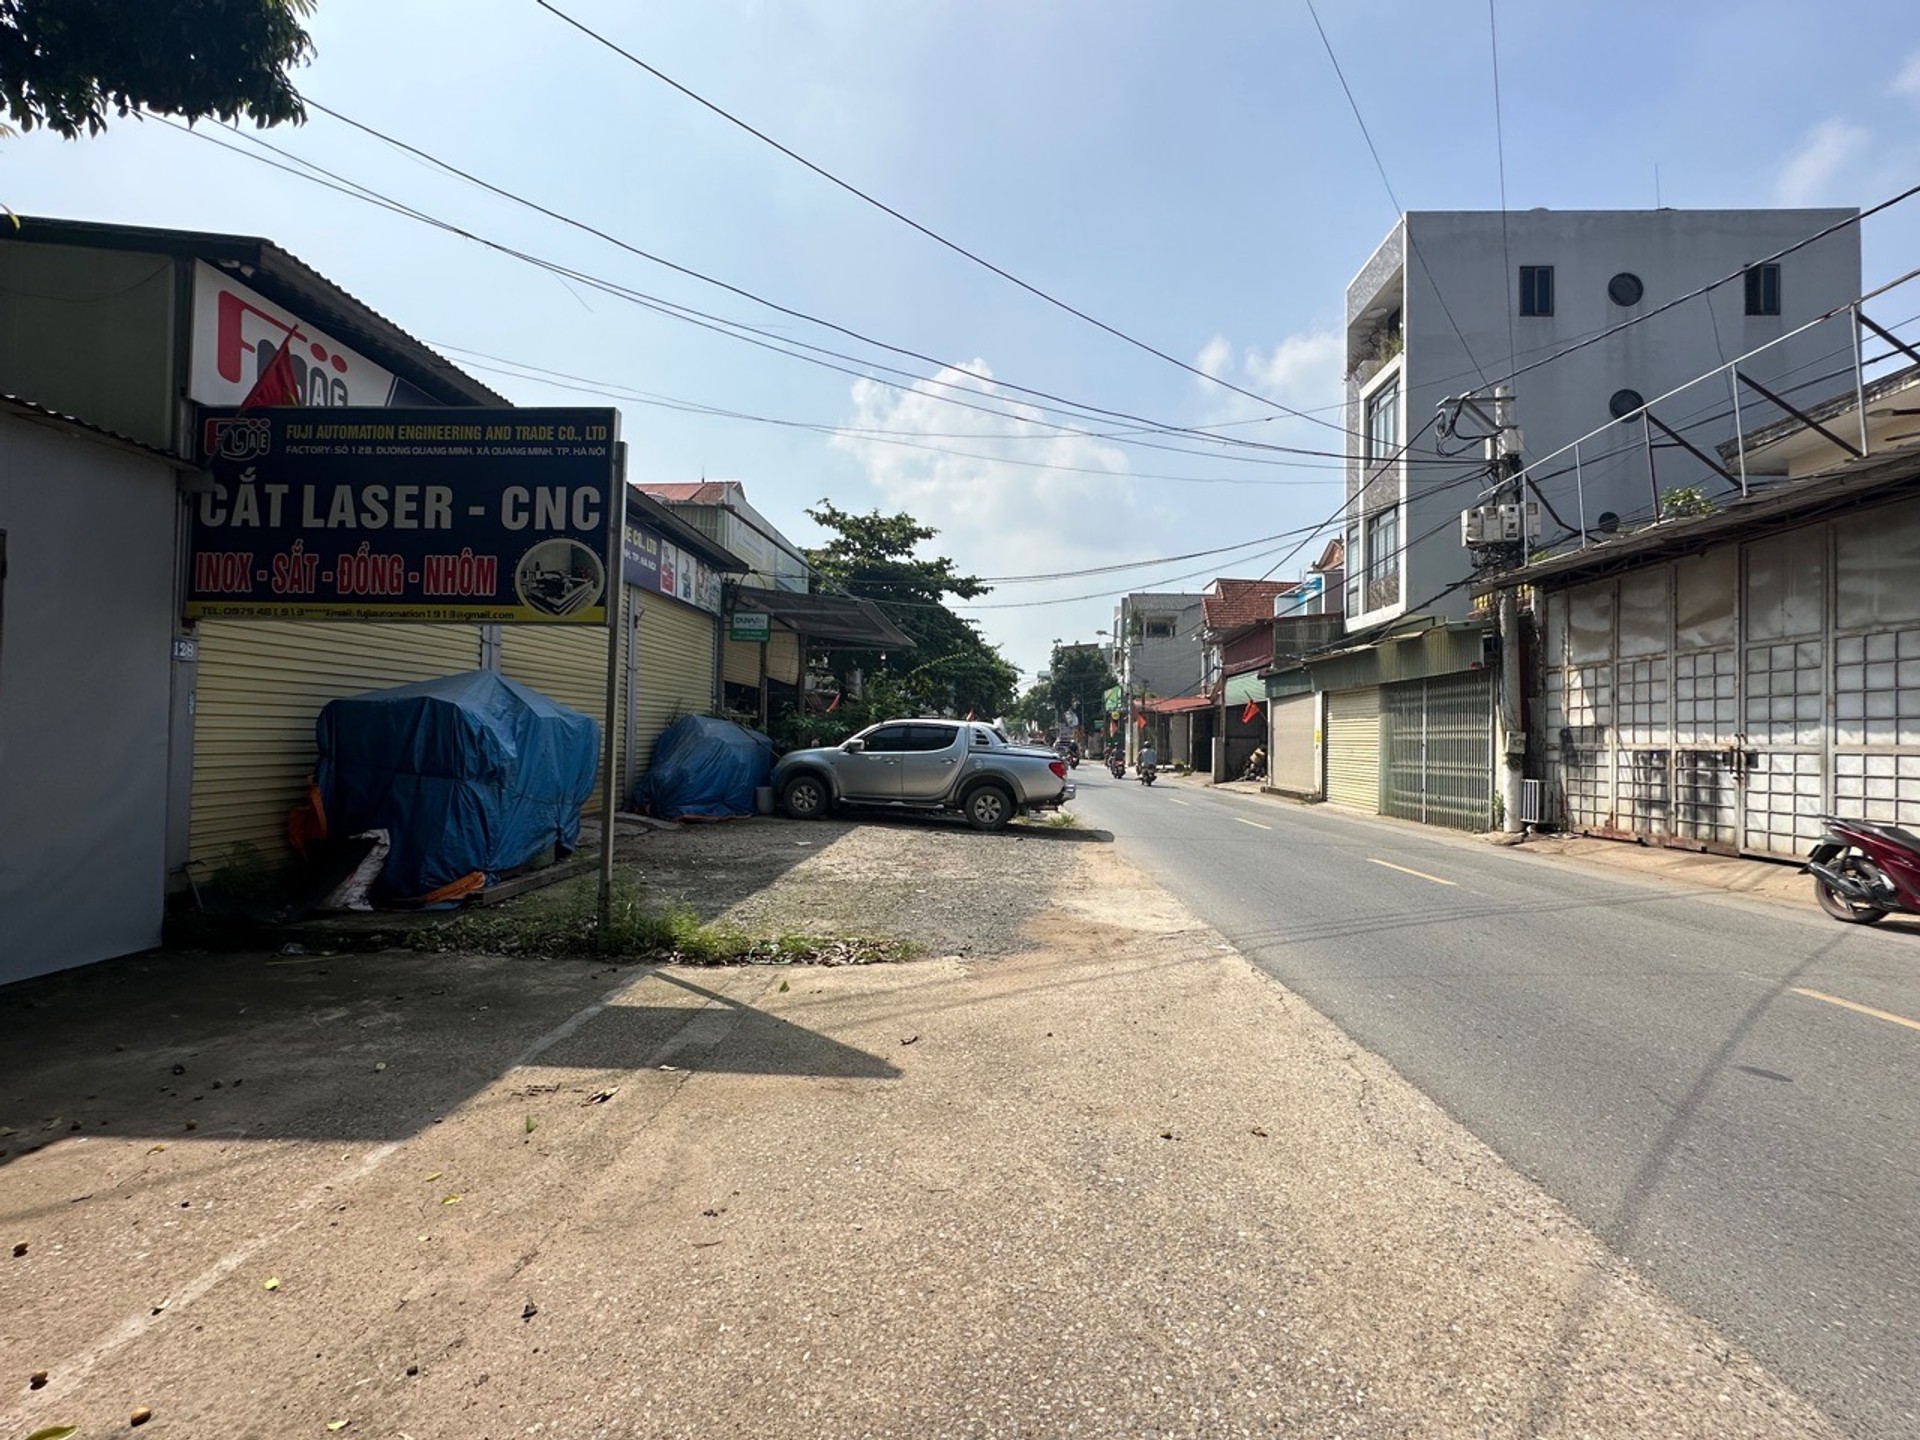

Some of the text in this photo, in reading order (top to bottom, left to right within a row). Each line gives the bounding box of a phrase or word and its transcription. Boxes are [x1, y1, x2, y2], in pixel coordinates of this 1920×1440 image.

[286, 424, 313, 440] FUJI
[315, 424, 395, 440] AUTOMATION
[398, 425, 482, 441] ENGINEERING
[484, 425, 512, 441] AND
[515, 425, 554, 441] TRADE
[585, 426, 607, 441] LTD
[412, 445, 446, 456] QUANG
[491, 446, 526, 457] QUANG
[199, 466, 290, 528] CẮT
[302, 484, 454, 529] LASER
[501, 485, 601, 531] CNC
[195, 551, 253, 593] INOX
[271, 539, 319, 593] SẮT
[423, 546, 498, 597] NHÔM
